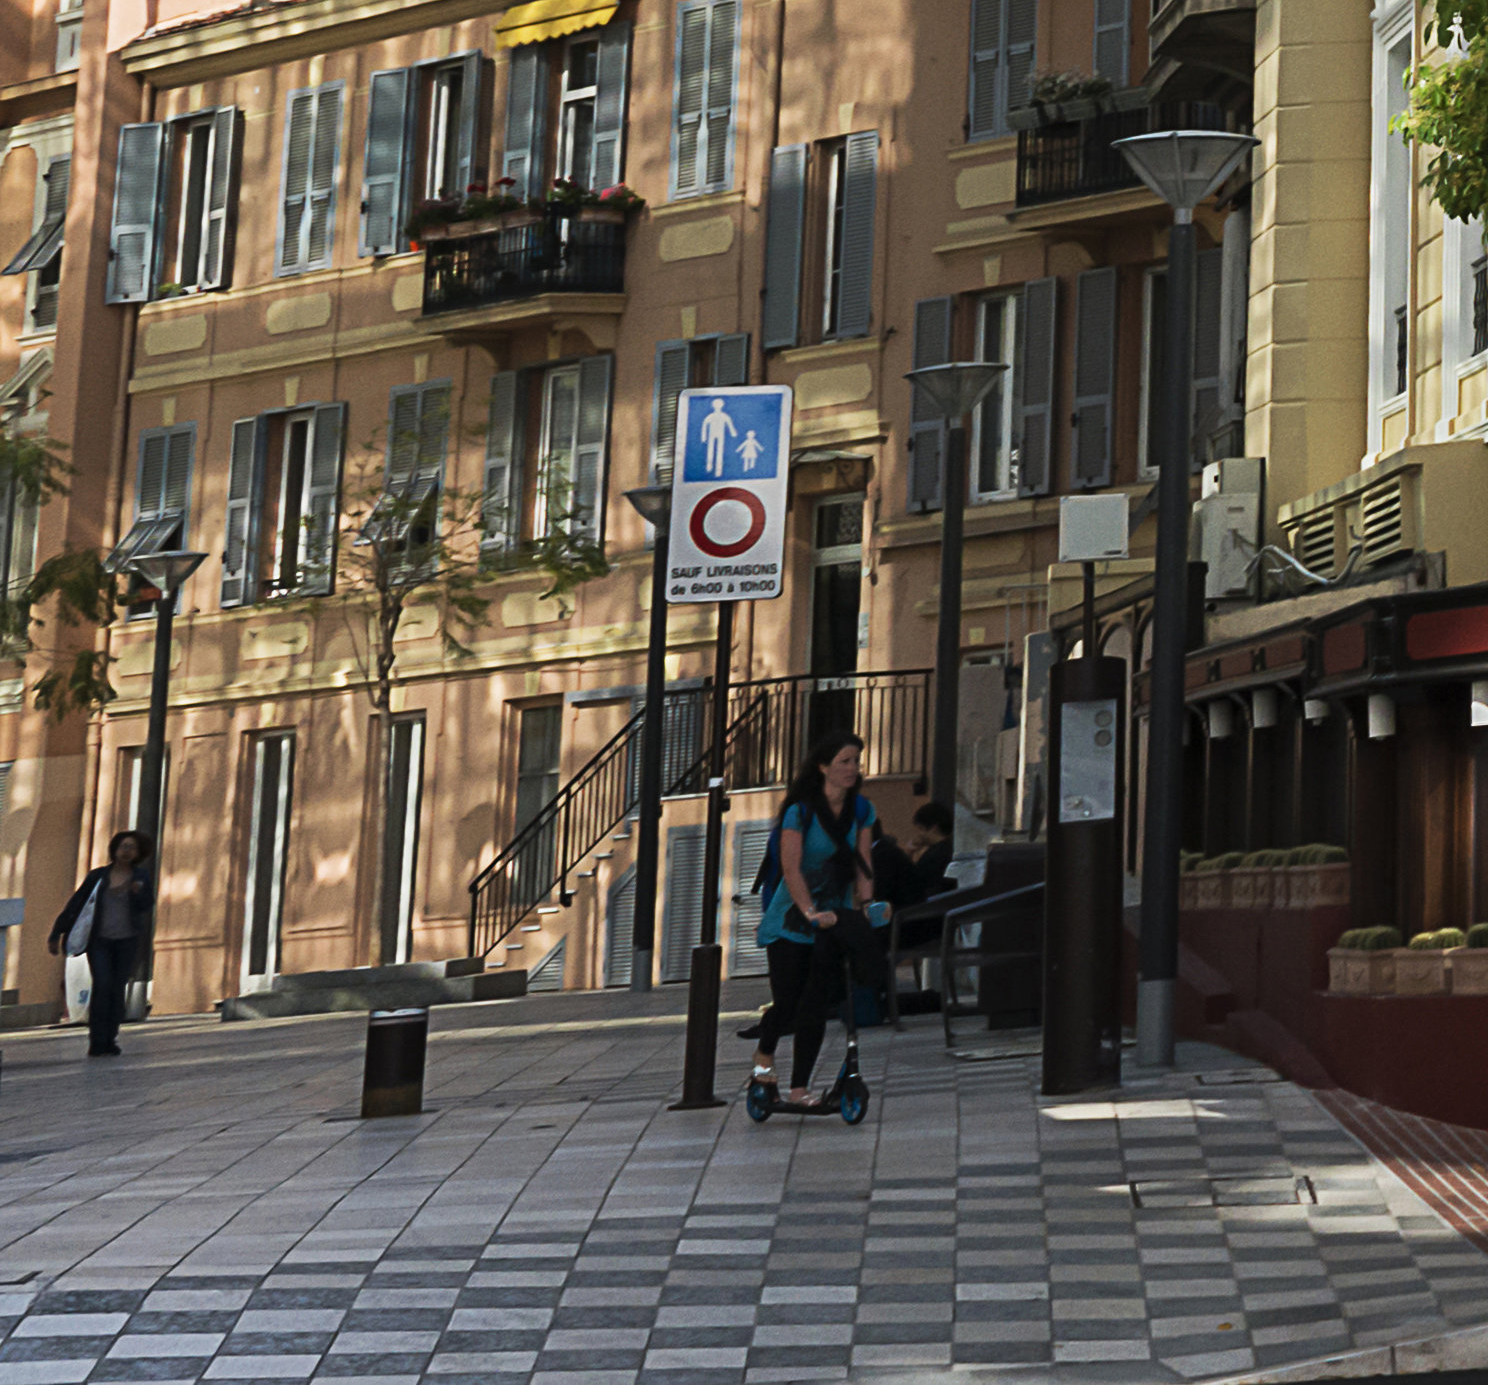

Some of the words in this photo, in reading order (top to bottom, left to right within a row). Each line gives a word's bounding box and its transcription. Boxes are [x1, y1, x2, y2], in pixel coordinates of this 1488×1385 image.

[671, 566, 702, 579] SAUF
[707, 563, 777, 577] LIVRAISONS
[671, 585, 685, 595] de
[691, 582, 722, 594] 6h00
[739, 580, 776, 592] 10h00
